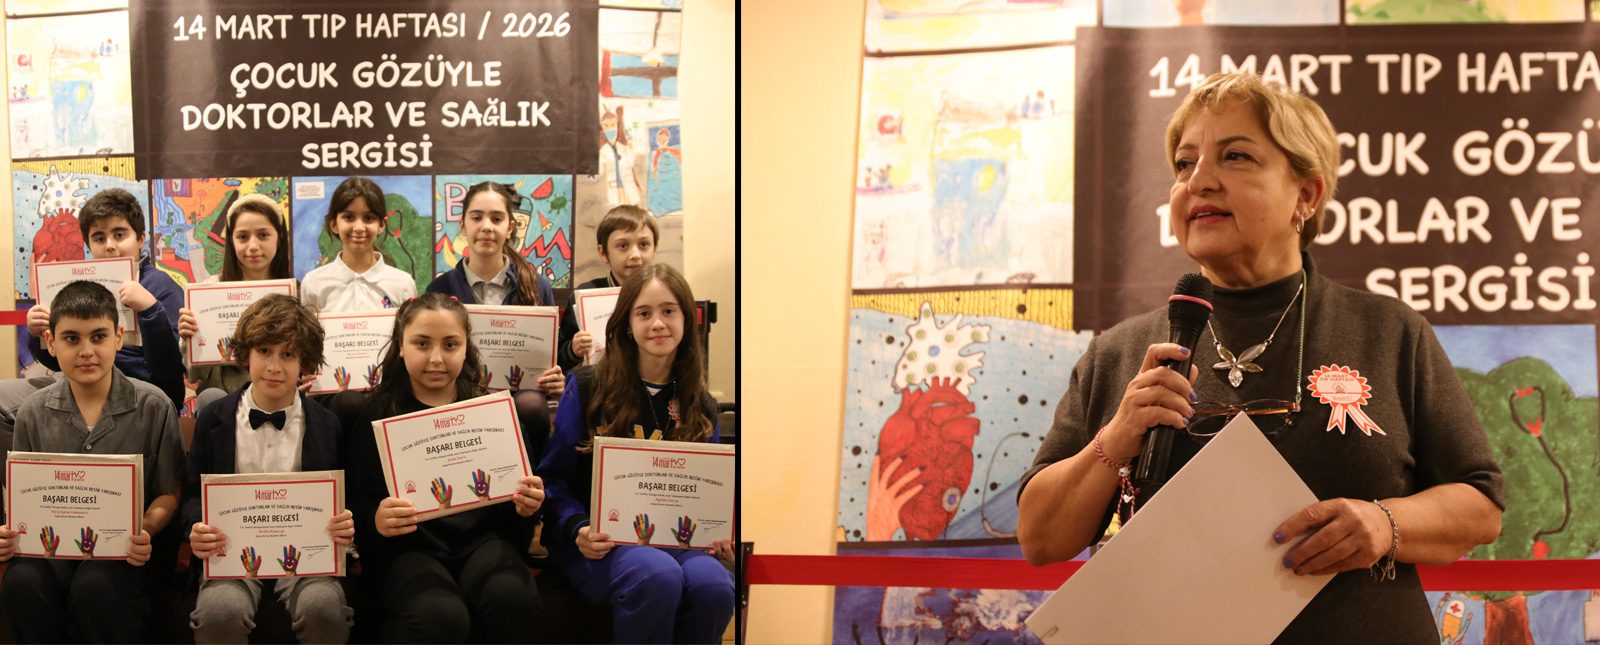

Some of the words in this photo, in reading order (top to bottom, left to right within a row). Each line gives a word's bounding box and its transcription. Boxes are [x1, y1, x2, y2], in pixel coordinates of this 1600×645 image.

[172, 14, 206, 40] 14
[216, 14, 294, 40] MART
[302, 14, 346, 40] TIP
[356, 12, 466, 39] HAFTASI
[477, 10, 492, 40] /
[502, 12, 571, 38] 2026
[230, 62, 339, 98] ÇOCUK
[352, 53, 502, 89] GÖZÜYLE
[1149, 53, 1205, 98] 14
[1366, 52, 1442, 94] TIP
[1458, 50, 1600, 94] HAFTA
[180, 101, 374, 131] DOKTORLAR
[384, 101, 426, 128] VE
[441, 98, 551, 128] SAĞLIK
[301, 133, 434, 169] SERGİSİ
[1336, 131, 1430, 177] CUK
[1508, 197, 1583, 244] VE
[1365, 252, 1597, 312] SERGİSİ
[426, 442, 453, 454] BAŞARI
[455, 436, 482, 449] BELGESİ
[42, 495, 68, 504] BAŞARI
[70, 495, 97, 504] BELGESİ
[638, 482, 666, 492] BAŞARI
[669, 483, 697, 493] BELGESİ
[243, 515, 270, 524] BAŞARI
[272, 513, 299, 522] BELGESİ
